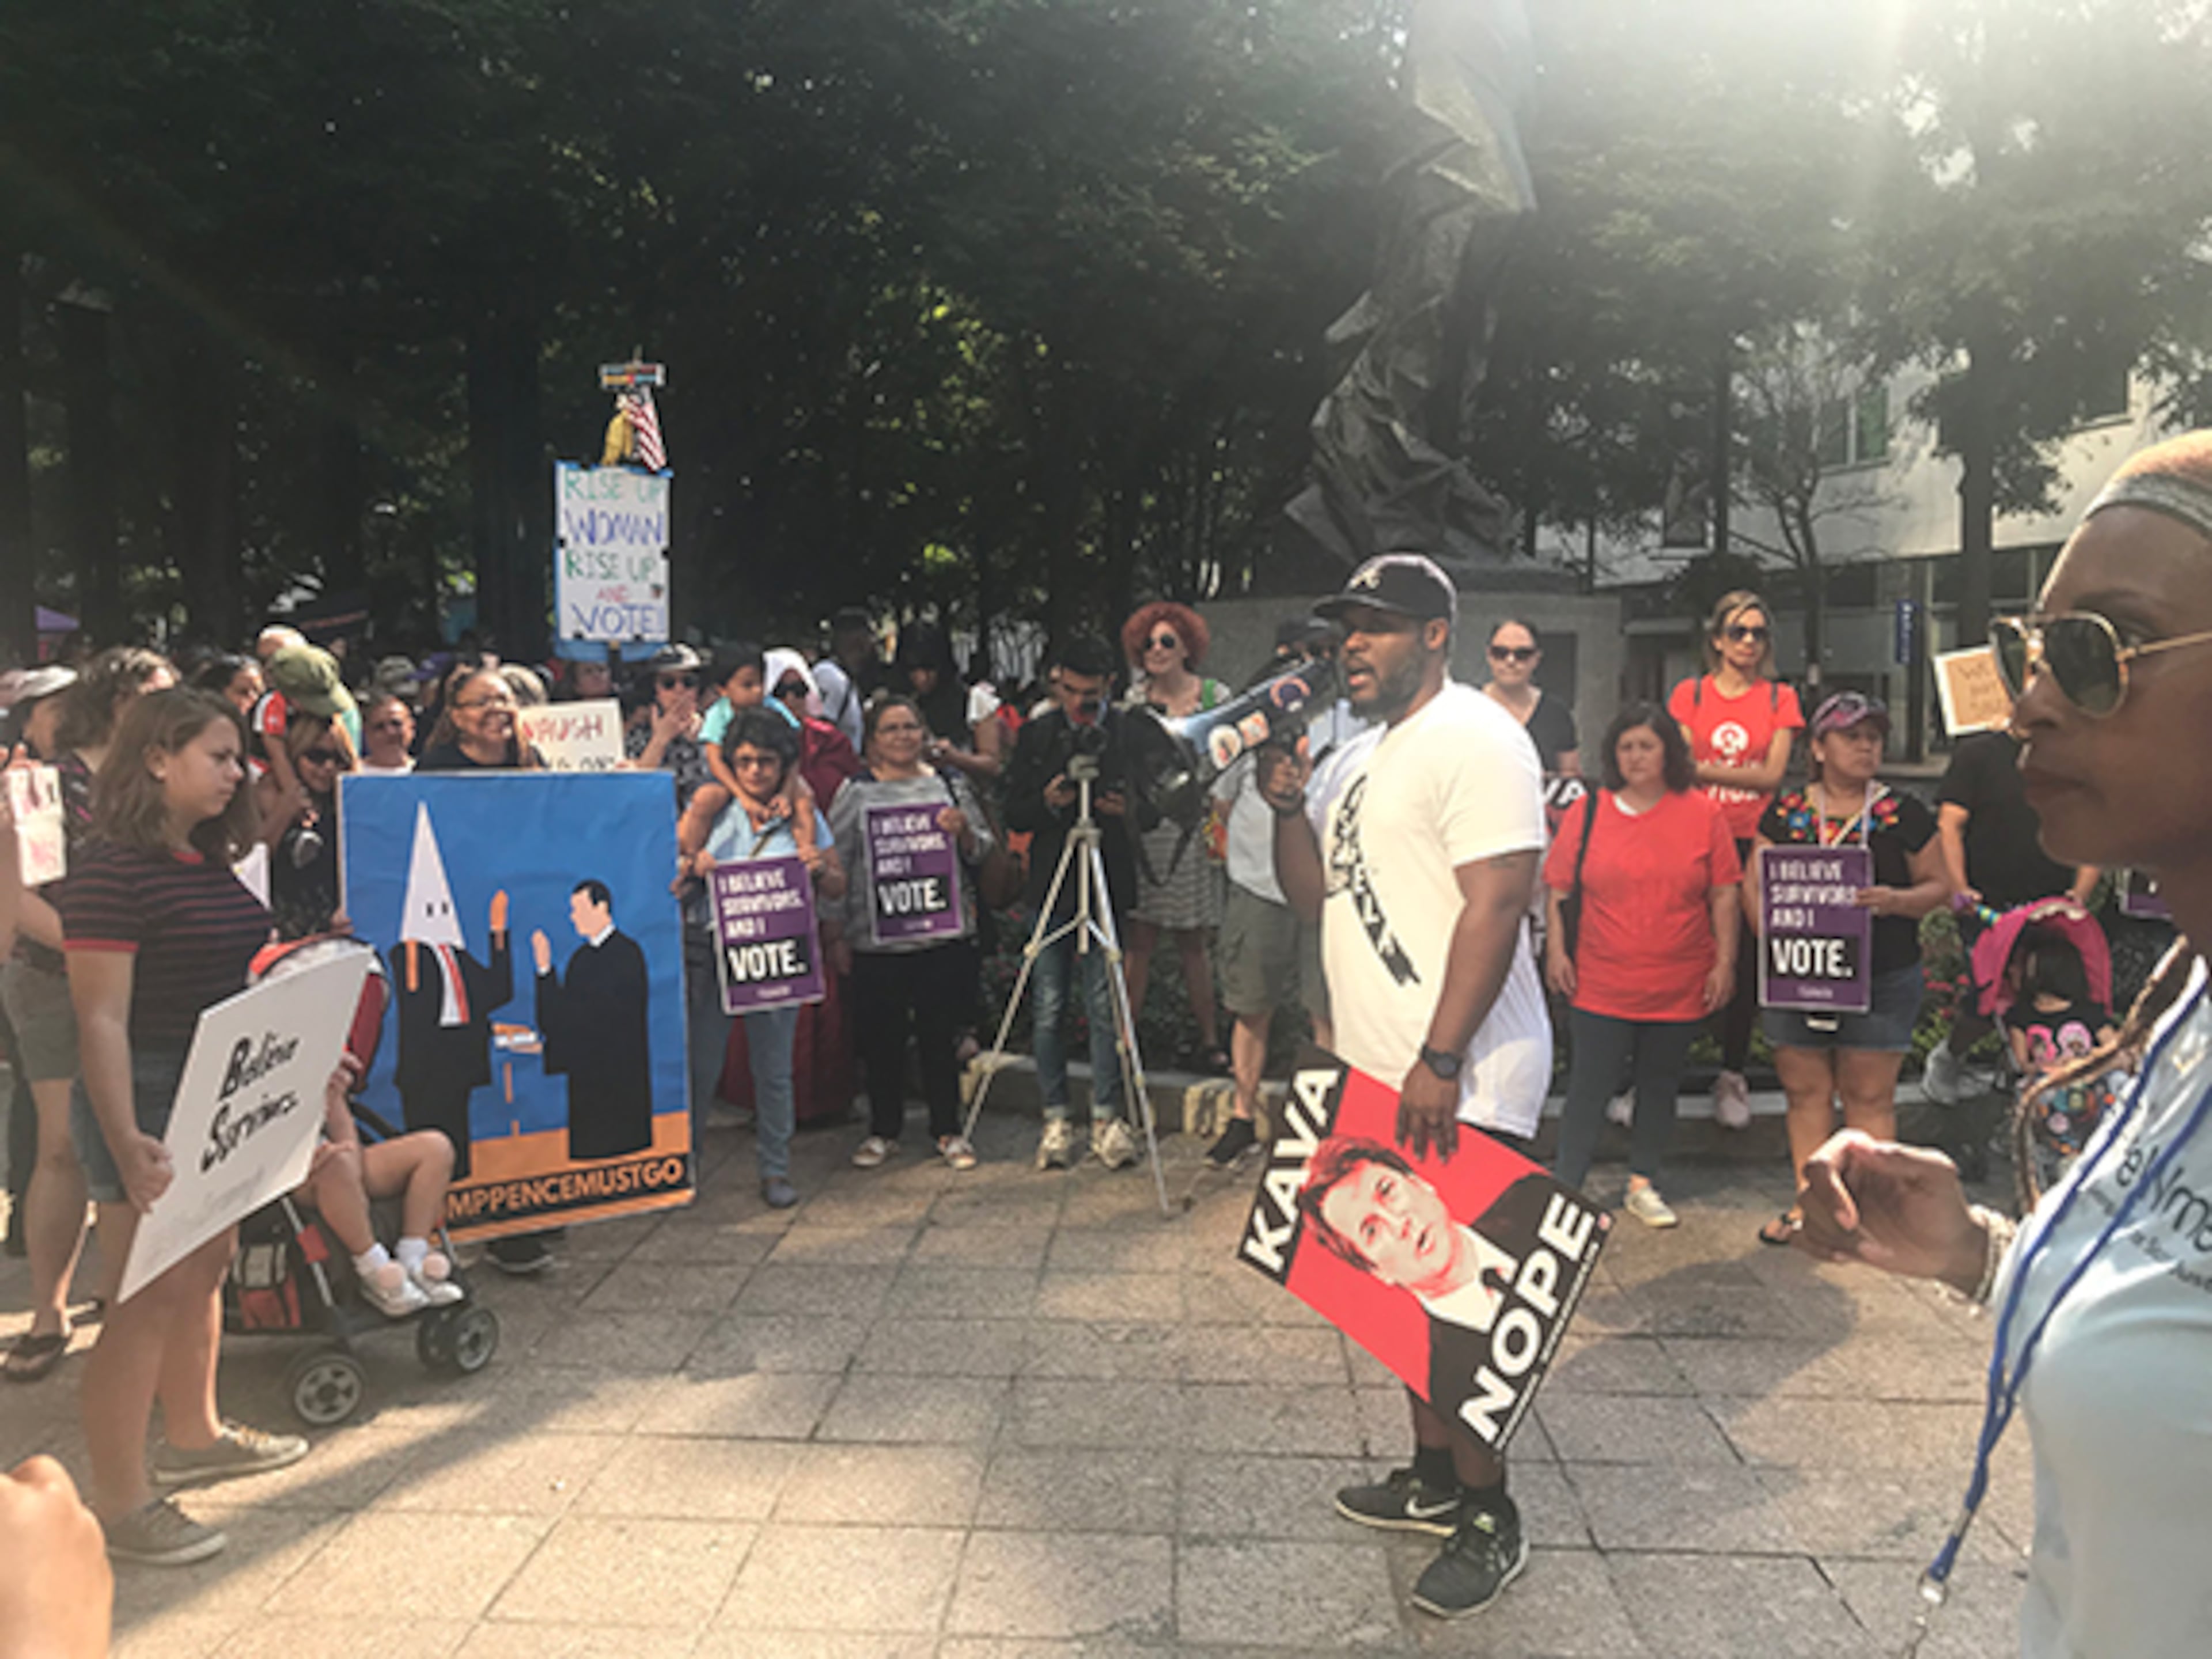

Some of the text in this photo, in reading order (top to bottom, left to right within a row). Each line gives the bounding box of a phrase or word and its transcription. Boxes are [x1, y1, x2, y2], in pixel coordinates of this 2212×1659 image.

[565, 470, 666, 503] RISE UP
[565, 508, 663, 546] WOMAN
[566, 550, 656, 582] RISE UP
[877, 878, 947, 914] VOTE.
[1771, 908, 1805, 928] AND
[727, 939, 806, 982] VOTE.
[1771, 939, 1854, 978] VOTE.
[1243, 1069, 1340, 1272] KAVA
[1458, 1191, 1596, 1444] NOPE
